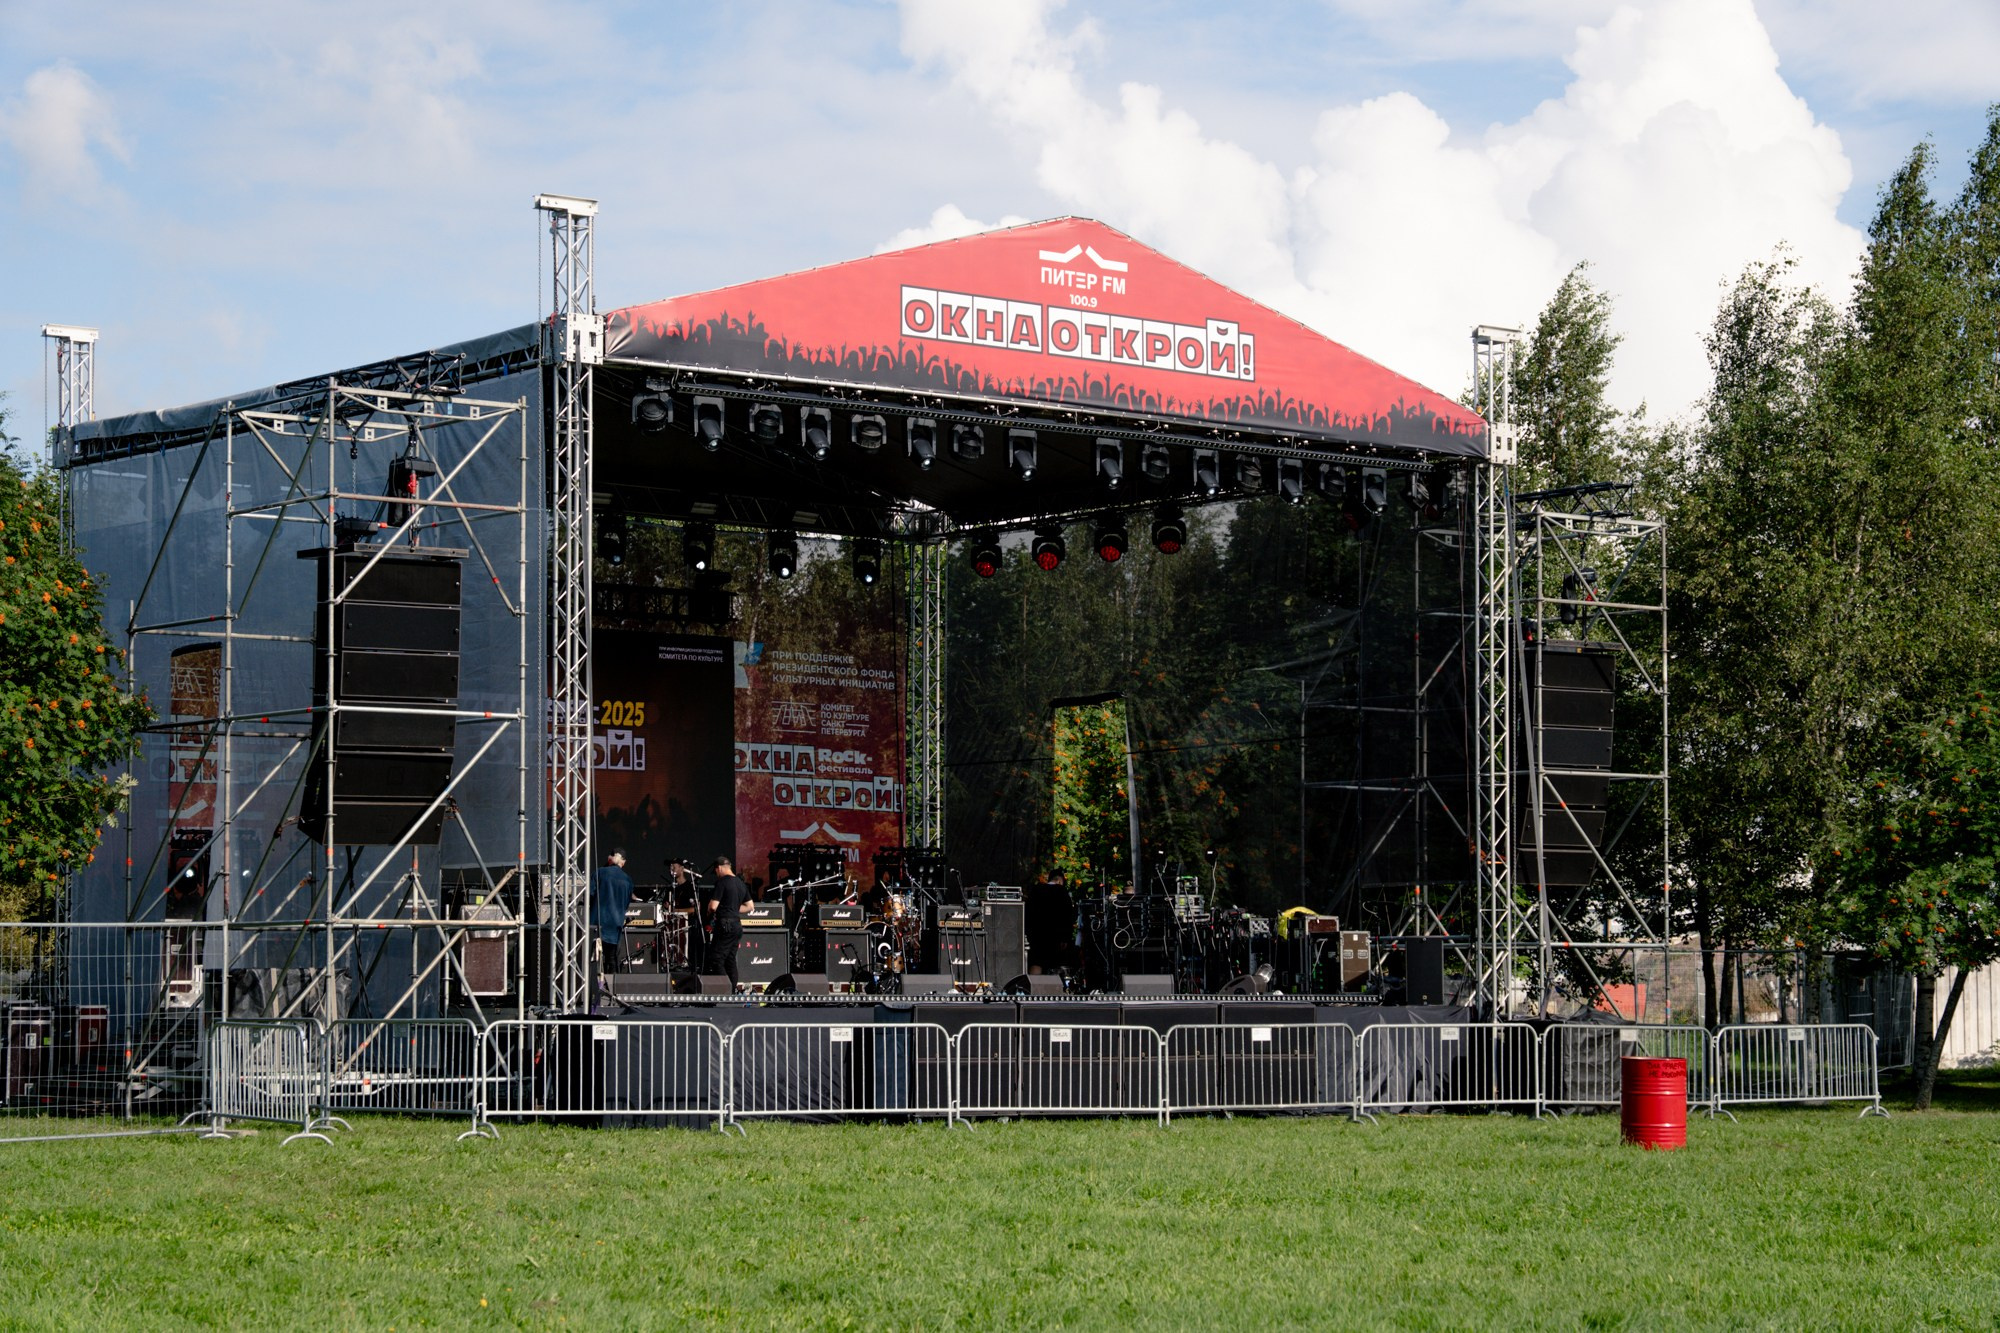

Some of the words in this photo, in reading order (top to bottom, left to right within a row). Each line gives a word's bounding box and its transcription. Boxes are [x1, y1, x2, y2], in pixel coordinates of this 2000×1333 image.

[1040, 267, 1098, 290] ПИТЕР
[1102, 276, 1126, 295] FM
[1069, 294, 1098, 308] 100.9
[903, 299, 1041, 350] ОКНА
[1051, 318, 1252, 376] ОТКРОЙ!
[772, 650, 793, 659] ПРИ
[795, 652, 855, 664] ПОДДЕРЖКЕ
[772, 662, 859, 677] ПРЕЗИДЕНТСКОГО
[861, 669, 895, 680] ФОНДА
[772, 674, 836, 686] КУЛЬТУРНЫХ
[839, 679, 896, 690] ИНИЦИАТИВ
[600, 699, 645, 727] 2025
[820, 704, 855, 712] КОМИТЕТ
[820, 711, 832, 719] ПО
[833, 712, 870, 722] КУЛЬТУРЕ
[820, 727, 866, 738] ПЕТЕРБУРГА
[818, 763, 873, 775] фестиваль
[750, 956, 773, 965] Marshall
